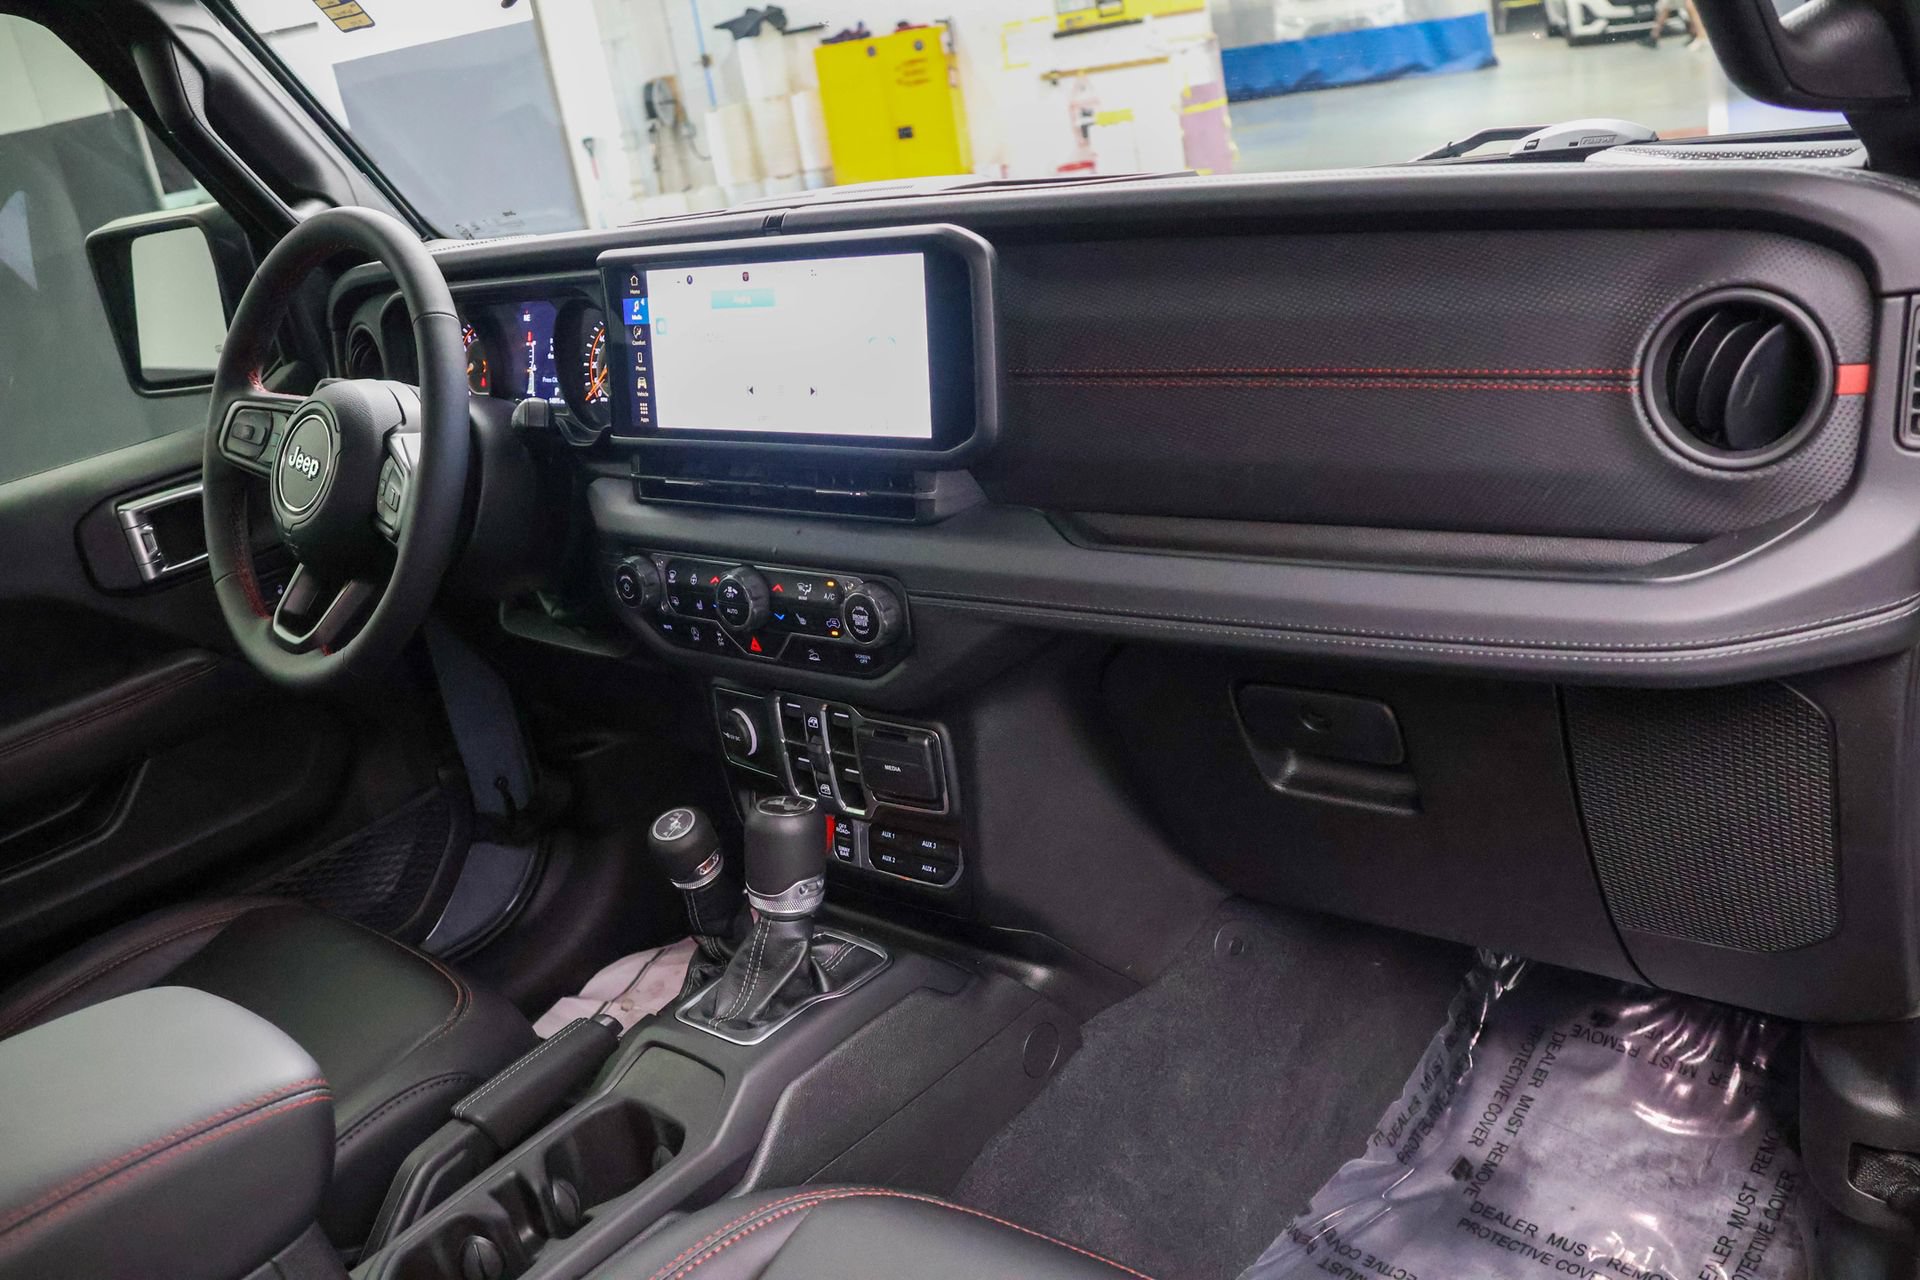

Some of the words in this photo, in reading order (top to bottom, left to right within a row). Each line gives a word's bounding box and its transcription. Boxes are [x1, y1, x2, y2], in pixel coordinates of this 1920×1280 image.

[289, 446, 321, 481] Jeep
[726, 607, 739, 615] AUTO
[823, 593, 836, 601] A/C
[884, 764, 902, 773] MEDIA
[881, 830, 892, 839] AUX
[921, 840, 933, 849] AUX
[881, 854, 892, 863] AUX
[921, 863, 933, 873] AUX
[1493, 1024, 1546, 1102] PROTECTIVE
[1528, 1031, 1568, 1089] DEALER
[1467, 1101, 1504, 1148] COVER
[1503, 1094, 1536, 1137] MUST
[1463, 1140, 1509, 1199] REMOVE
[1469, 1200, 1539, 1238] DEALER
[1698, 1234, 1737, 1280] EALER
[1726, 1181, 1759, 1231] MUST
[1731, 1221, 1777, 1280] OTECTIVE
[1763, 1169, 1799, 1222] COVER
[1457, 1217, 1555, 1266] PROTECTIVE
[1317, 1256, 1368, 1280] MUST
[1362, 1254, 1418, 1280] ECTIVE
